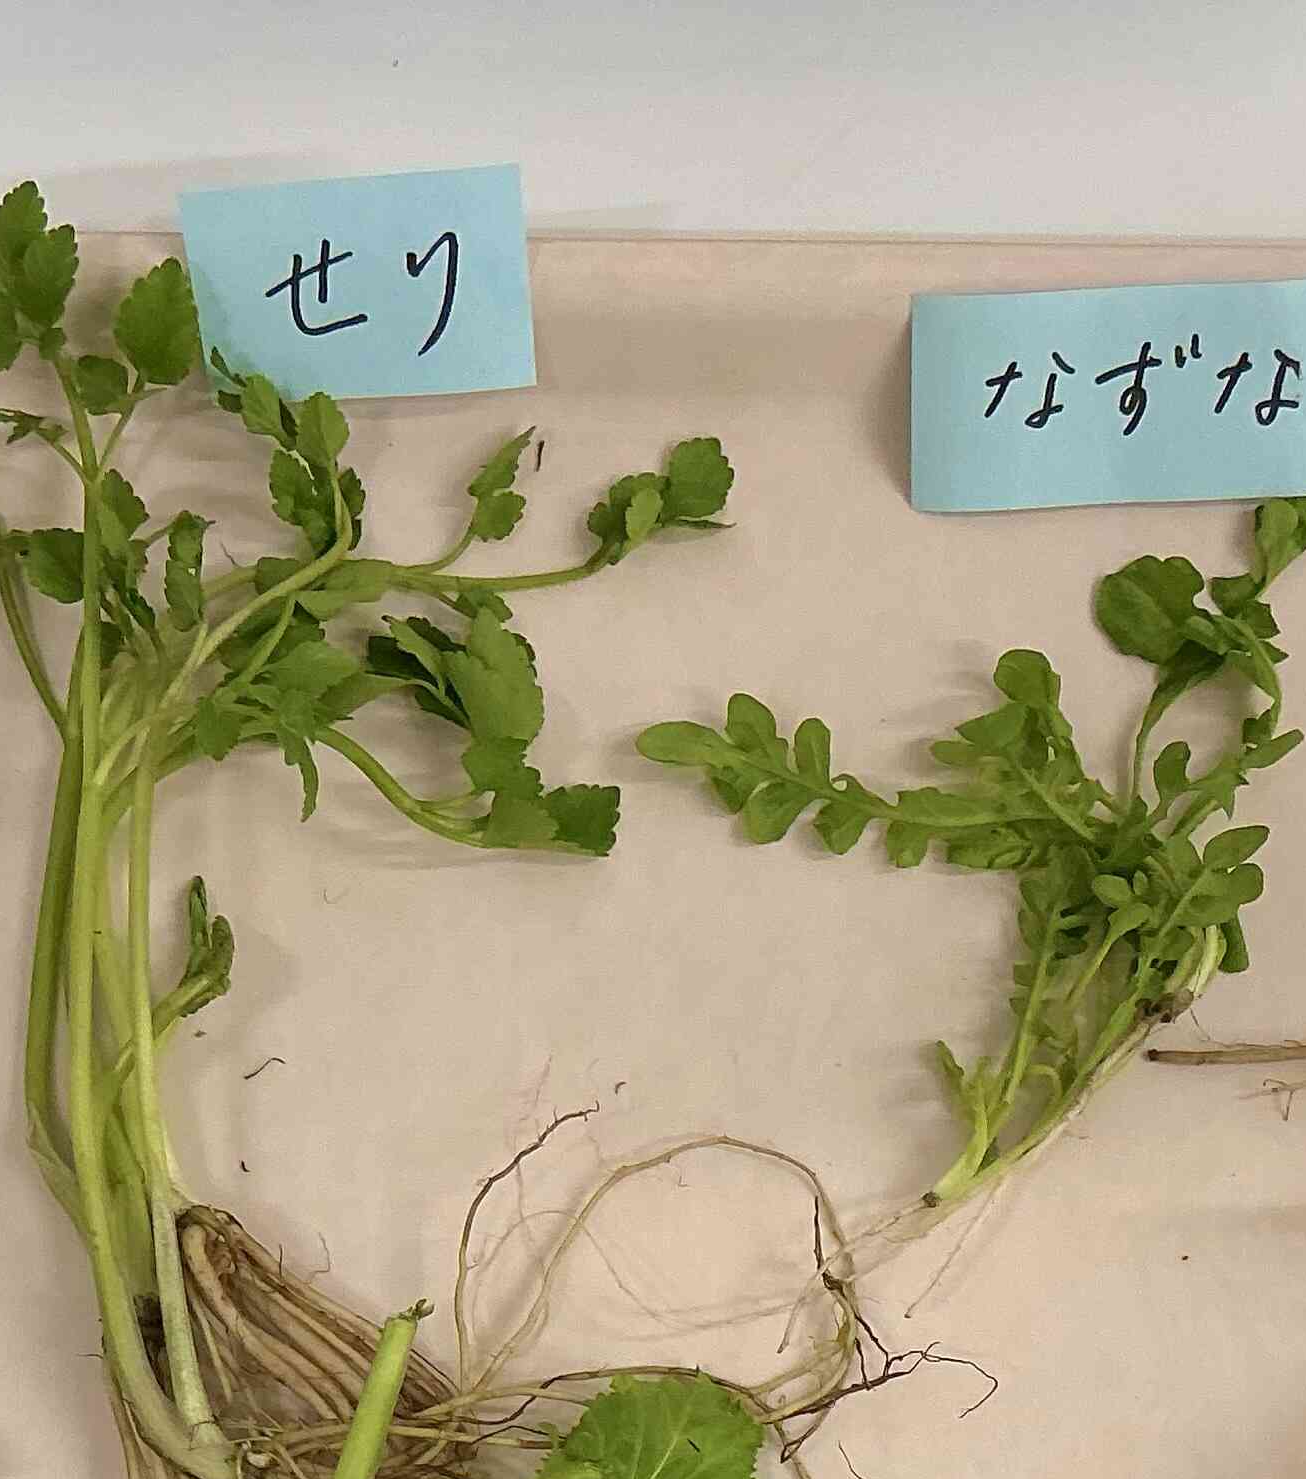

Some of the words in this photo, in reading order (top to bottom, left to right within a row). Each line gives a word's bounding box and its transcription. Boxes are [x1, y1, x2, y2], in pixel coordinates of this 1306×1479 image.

[263, 230, 460, 356] せり
[985, 334, 1302, 437] なずな
